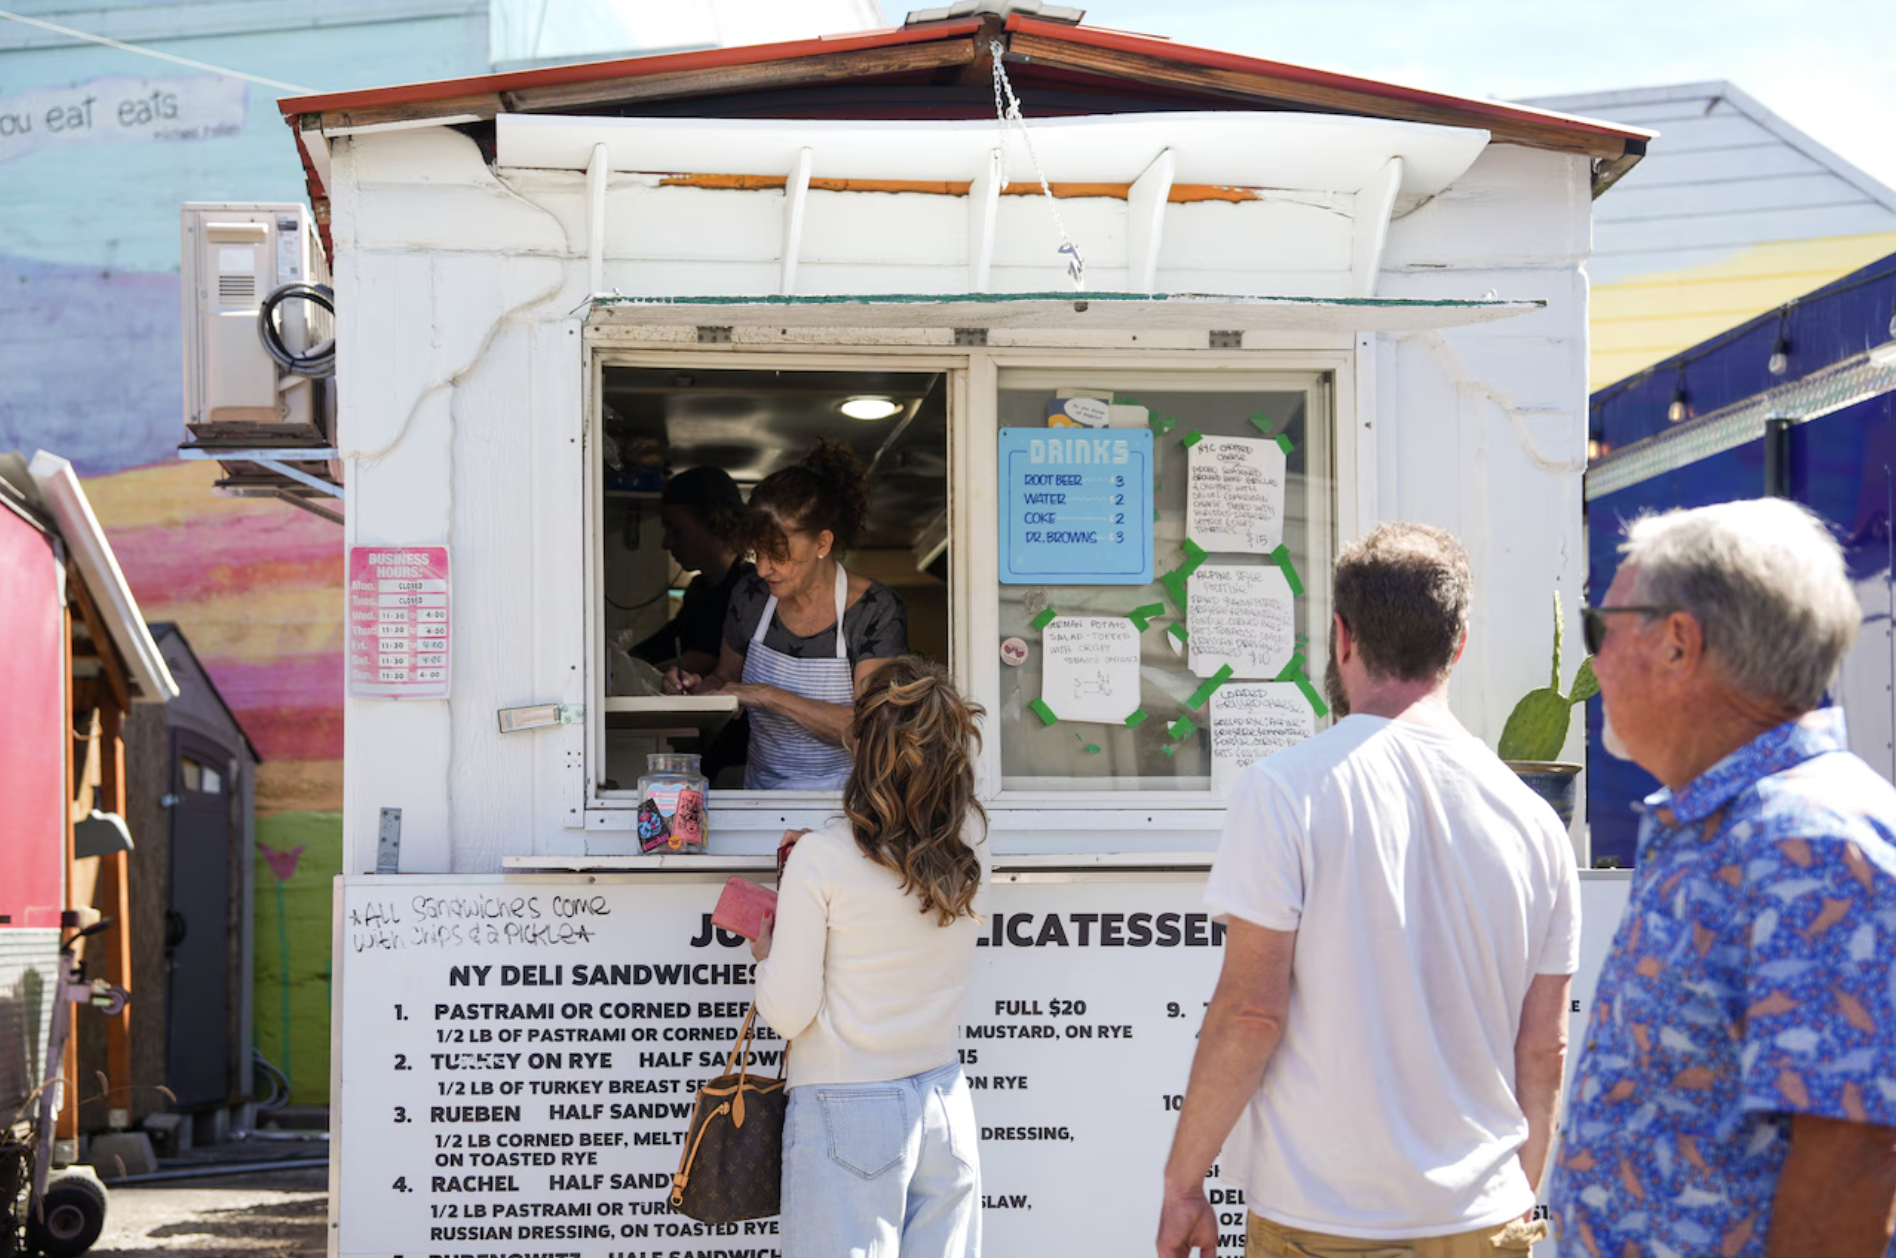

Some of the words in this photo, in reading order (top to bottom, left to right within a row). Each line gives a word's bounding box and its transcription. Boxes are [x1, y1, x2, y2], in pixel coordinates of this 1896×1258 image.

[0, 112, 31, 137] ou
[46, 95, 96, 132] eat
[117, 90, 179, 127] eats
[1030, 439, 1129, 464] DRINKS
[1024, 474, 1053, 486] ROOT
[1056, 474, 1082, 486] BEER
[1024, 493, 1066, 505] WATER
[1024, 512, 1056, 524] COKE
[1026, 531, 1045, 543] DR.
[1047, 531, 1097, 543] BROWNS
[368, 553, 429, 565] BUSINESS
[377, 567, 423, 578] HOURS:
[1091, 620, 1126, 630] POTATO
[1049, 633, 1083, 642] SALAD
[411, 894, 541, 922] Sandwiches
[552, 896, 611, 918] come
[976, 912, 1229, 948] ICATESSE
[449, 966, 492, 986] NY
[500, 965, 562, 986] DELI
[394, 1005, 408, 1020] 1.
[434, 1003, 553, 1020] PASTRAMI
[560, 1003, 593, 1019] OR
[599, 1003, 691, 1018] CORNED
[697, 1002, 749, 1018] BEEF
[995, 1001, 1043, 1015] FULL
[1048, 998, 1086, 1017] $20
[1166, 1002, 1185, 1018] 9.
[436, 1030, 463, 1042] 1/2
[469, 1030, 492, 1042] LB
[497, 1029, 522, 1042] OF
[527, 1028, 625, 1042] PASTRAMI
[631, 1028, 657, 1041] OR
[662, 1028, 737, 1041] CORNED
[744, 1027, 782, 1041] BEE
[965, 1025, 1060, 1039] MUSTARD,
[1064, 1025, 1092, 1038] ON
[1097, 1025, 1132, 1038] RYE
[394, 1054, 412, 1070] 2.
[430, 1053, 521, 1070] TURKEY
[527, 1053, 561, 1069] ON
[568, 1053, 611, 1068] RYE
[639, 1052, 693, 1067] HALF
[438, 1082, 465, 1095] 1/2
[470, 1082, 494, 1095] LB
[499, 1082, 524, 1094] OF
[528, 1081, 603, 1094] TURKEY
[608, 1080, 680, 1093] BREAST
[993, 1076, 1029, 1090] RYE
[393, 1107, 411, 1123] 3.
[430, 1106, 520, 1122] RUEBEN
[549, 1104, 604, 1119] HALF
[435, 1135, 462, 1148] 1/2
[467, 1135, 491, 1147] LB
[496, 1134, 573, 1147] CORNED
[579, 1133, 628, 1147] BEEF,
[981, 1127, 1073, 1141] DRESSING,
[435, 1154, 463, 1167] ON
[468, 1153, 555, 1166] TOASTED
[561, 1152, 597, 1165] RYE
[392, 1177, 412, 1192] 4.
[431, 1176, 519, 1192] RACHEL
[549, 1175, 604, 1190] HALF
[610, 1174, 673, 1190] SAND
[430, 1205, 457, 1218] 1/2
[463, 1205, 486, 1217] LB
[492, 1203, 591, 1217] PASTRAMI
[596, 1203, 623, 1216] OR
[1220, 1213, 1244, 1226] OZ
[430, 1227, 512, 1240] RUSSIAN
[518, 1225, 614, 1239] DRESSING,
[620, 1224, 648, 1237] ON
[653, 1221, 738, 1237] TOASTED
[741, 1219, 779, 1235] RYE
